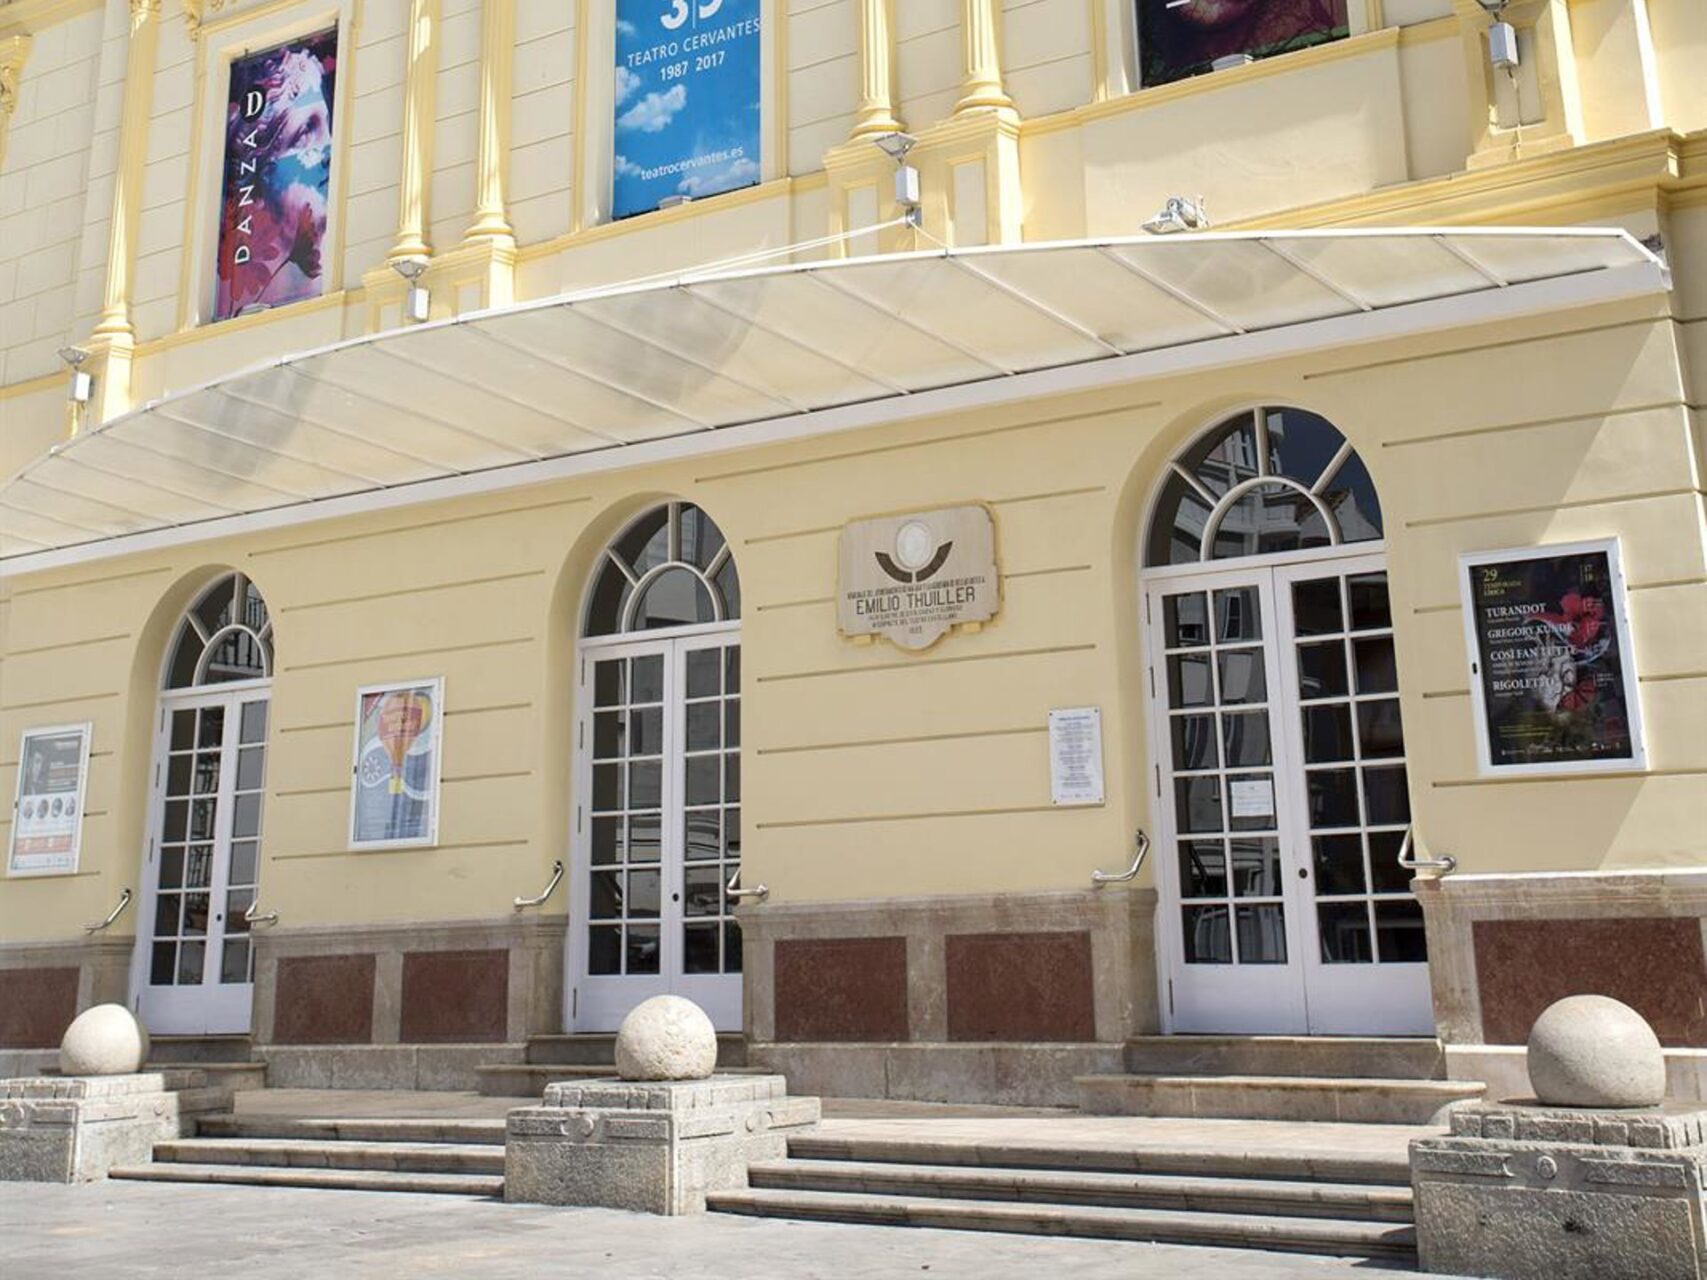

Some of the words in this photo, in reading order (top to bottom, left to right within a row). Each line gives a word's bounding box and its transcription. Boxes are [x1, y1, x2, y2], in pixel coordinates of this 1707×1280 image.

[627, 42, 678, 68] TEATRO
[682, 17, 760, 53] CERVANTES
[660, 61, 689, 82] 1987
[695, 50, 726, 73] 2017
[641, 145, 743, 181] teatrocervantes.es
[234, 129, 258, 265] DANZA
[856, 595, 900, 615] EMILIO
[906, 586, 976, 609] THUILLER
[1485, 602, 1547, 619] TURANDOT
[1487, 625, 1535, 639] GREGORY
